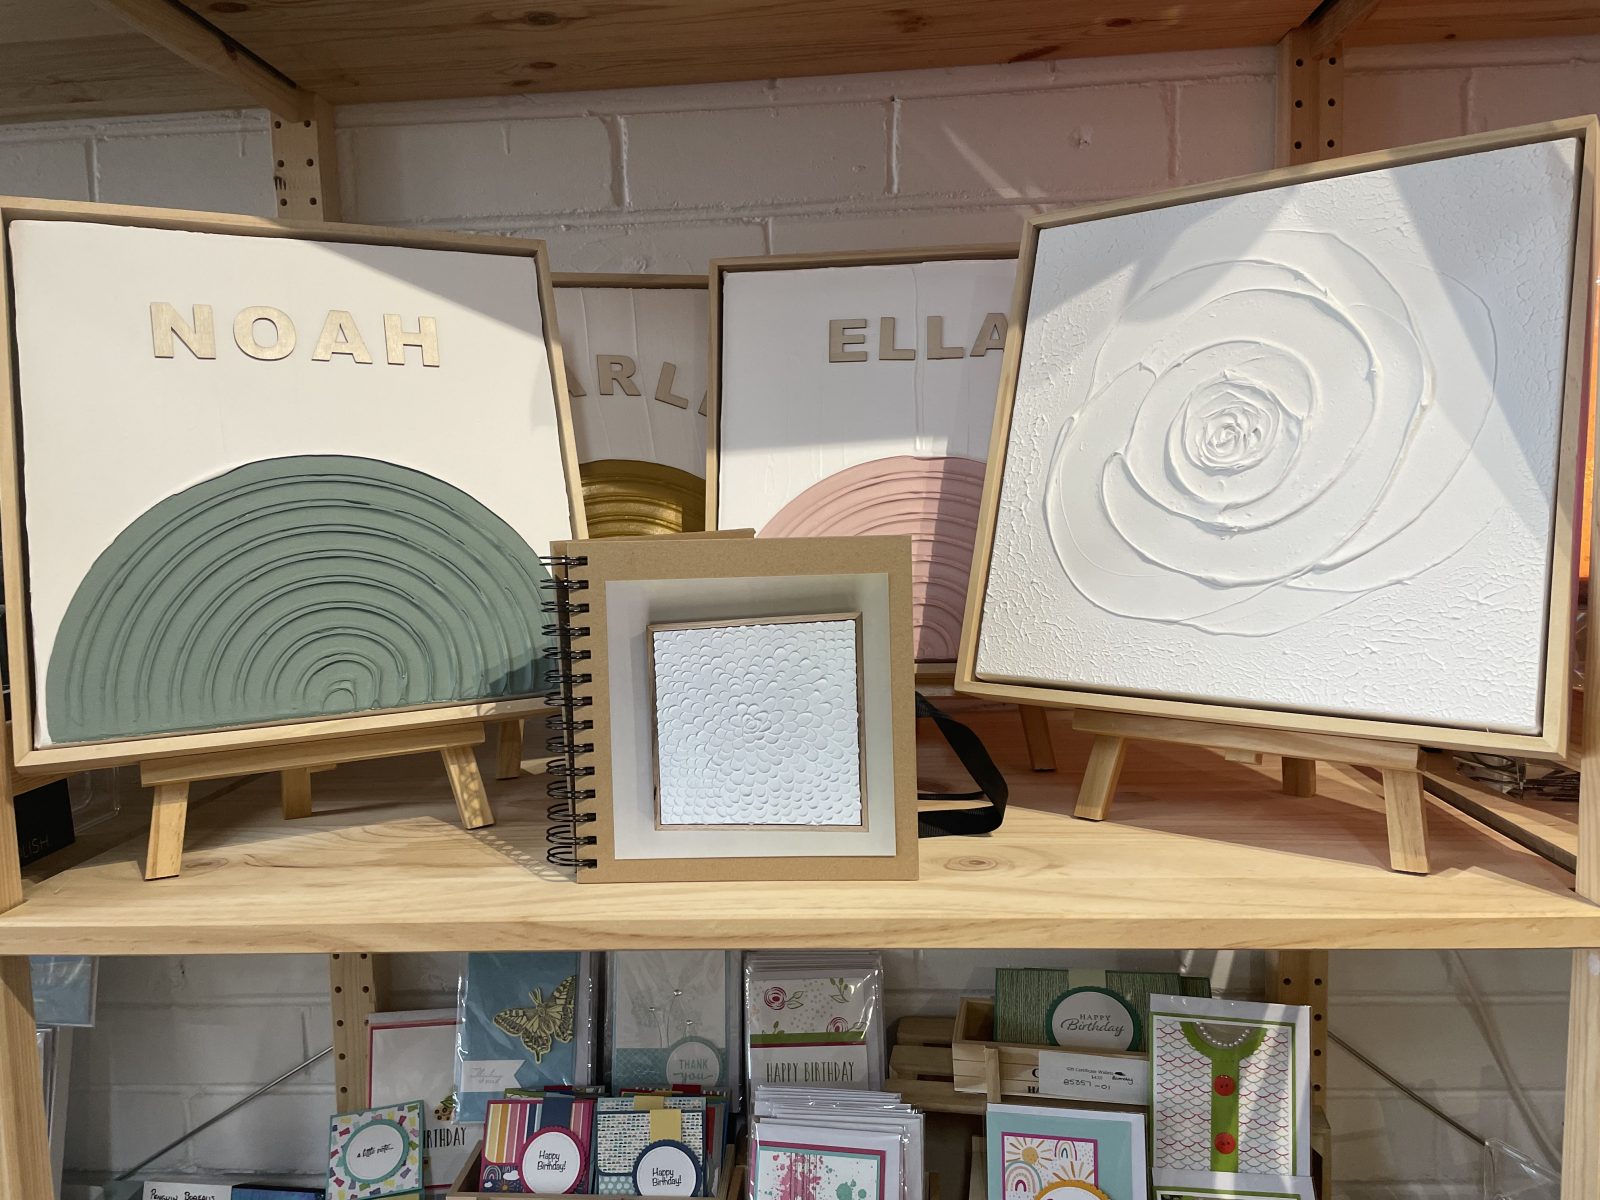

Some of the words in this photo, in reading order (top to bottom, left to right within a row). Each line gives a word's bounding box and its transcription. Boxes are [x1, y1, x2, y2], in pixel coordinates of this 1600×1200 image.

[150, 302, 440, 367] NOAH
[829, 313, 1007, 362] ELLA
[1060, 1018, 1125, 1037] Birthday
[679, 1059, 708, 1070] THANK
[766, 1062, 798, 1083] HAPPY
[804, 1061, 854, 1082] BIRTHDAY
[538, 1150, 561, 1165] Happy
[537, 1159, 567, 1173] Birthday!
[652, 1167, 674, 1182] Happy
[652, 1175, 682, 1187] Birthday!
